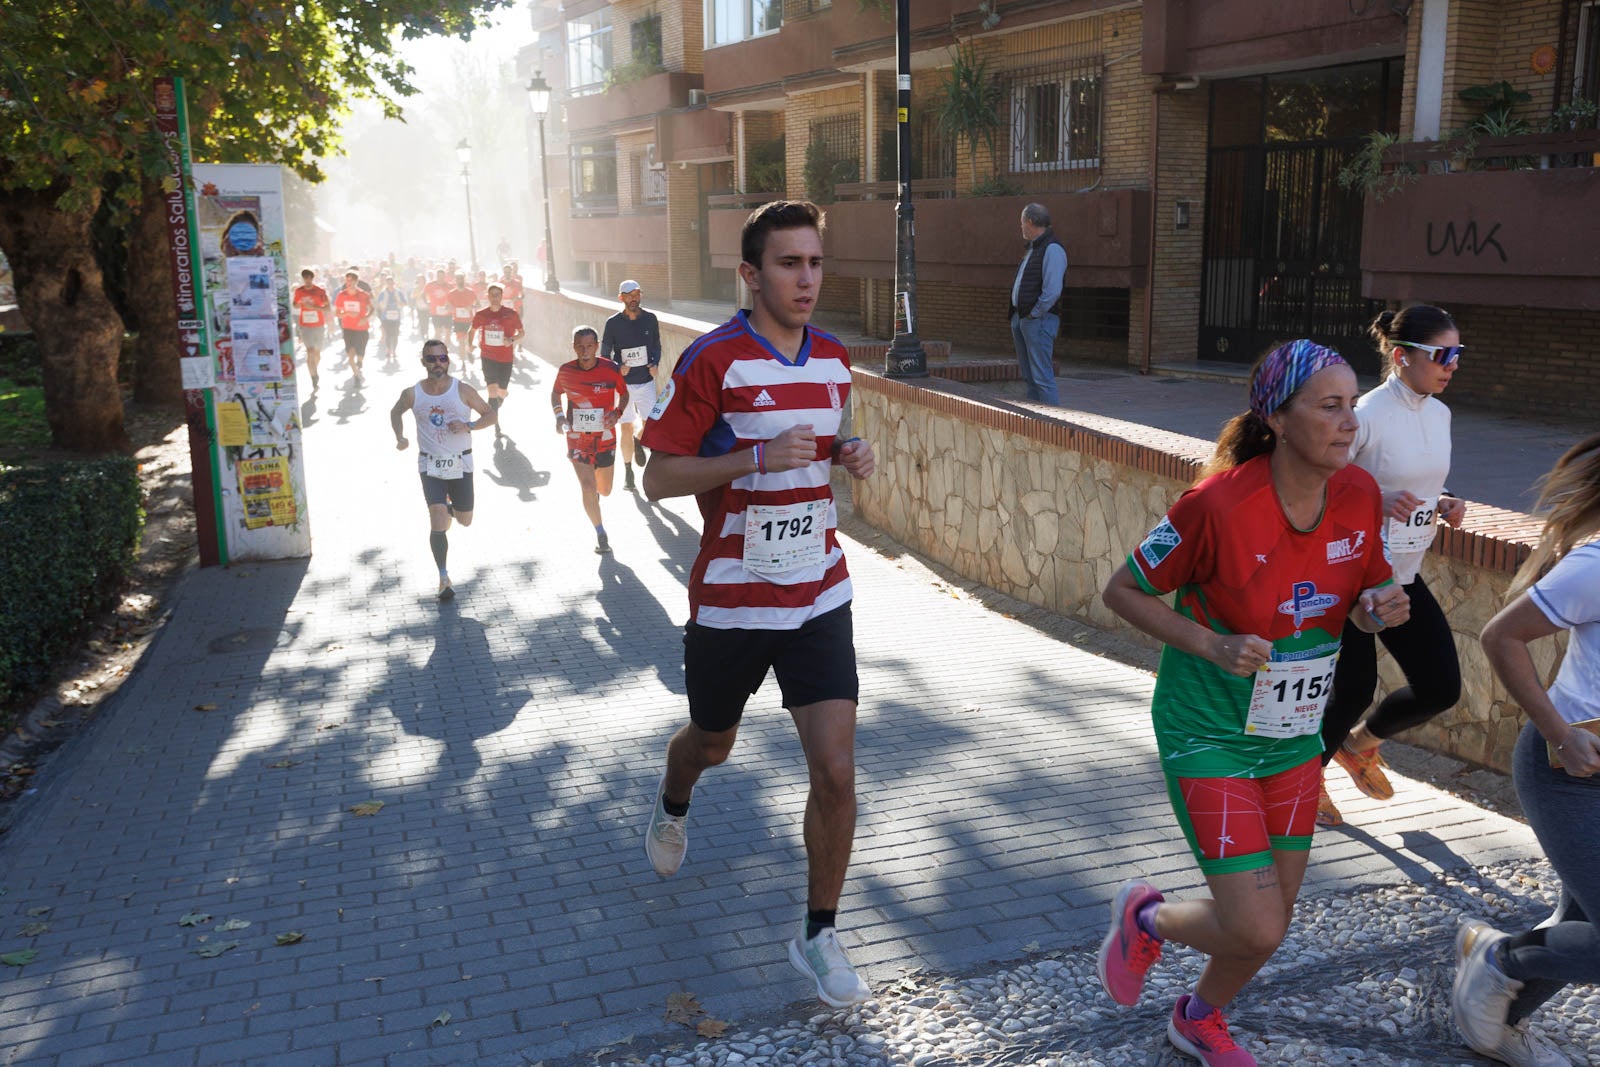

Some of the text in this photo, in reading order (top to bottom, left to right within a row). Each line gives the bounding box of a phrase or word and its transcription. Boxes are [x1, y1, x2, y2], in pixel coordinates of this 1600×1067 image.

[753, 399, 776, 407] adidas
[579, 414, 596, 422] 796
[435, 459, 454, 468] 870
[761, 515, 813, 541] 1792
[1273, 671, 1333, 702] 1152
[1294, 703, 1318, 713] NIEVES
